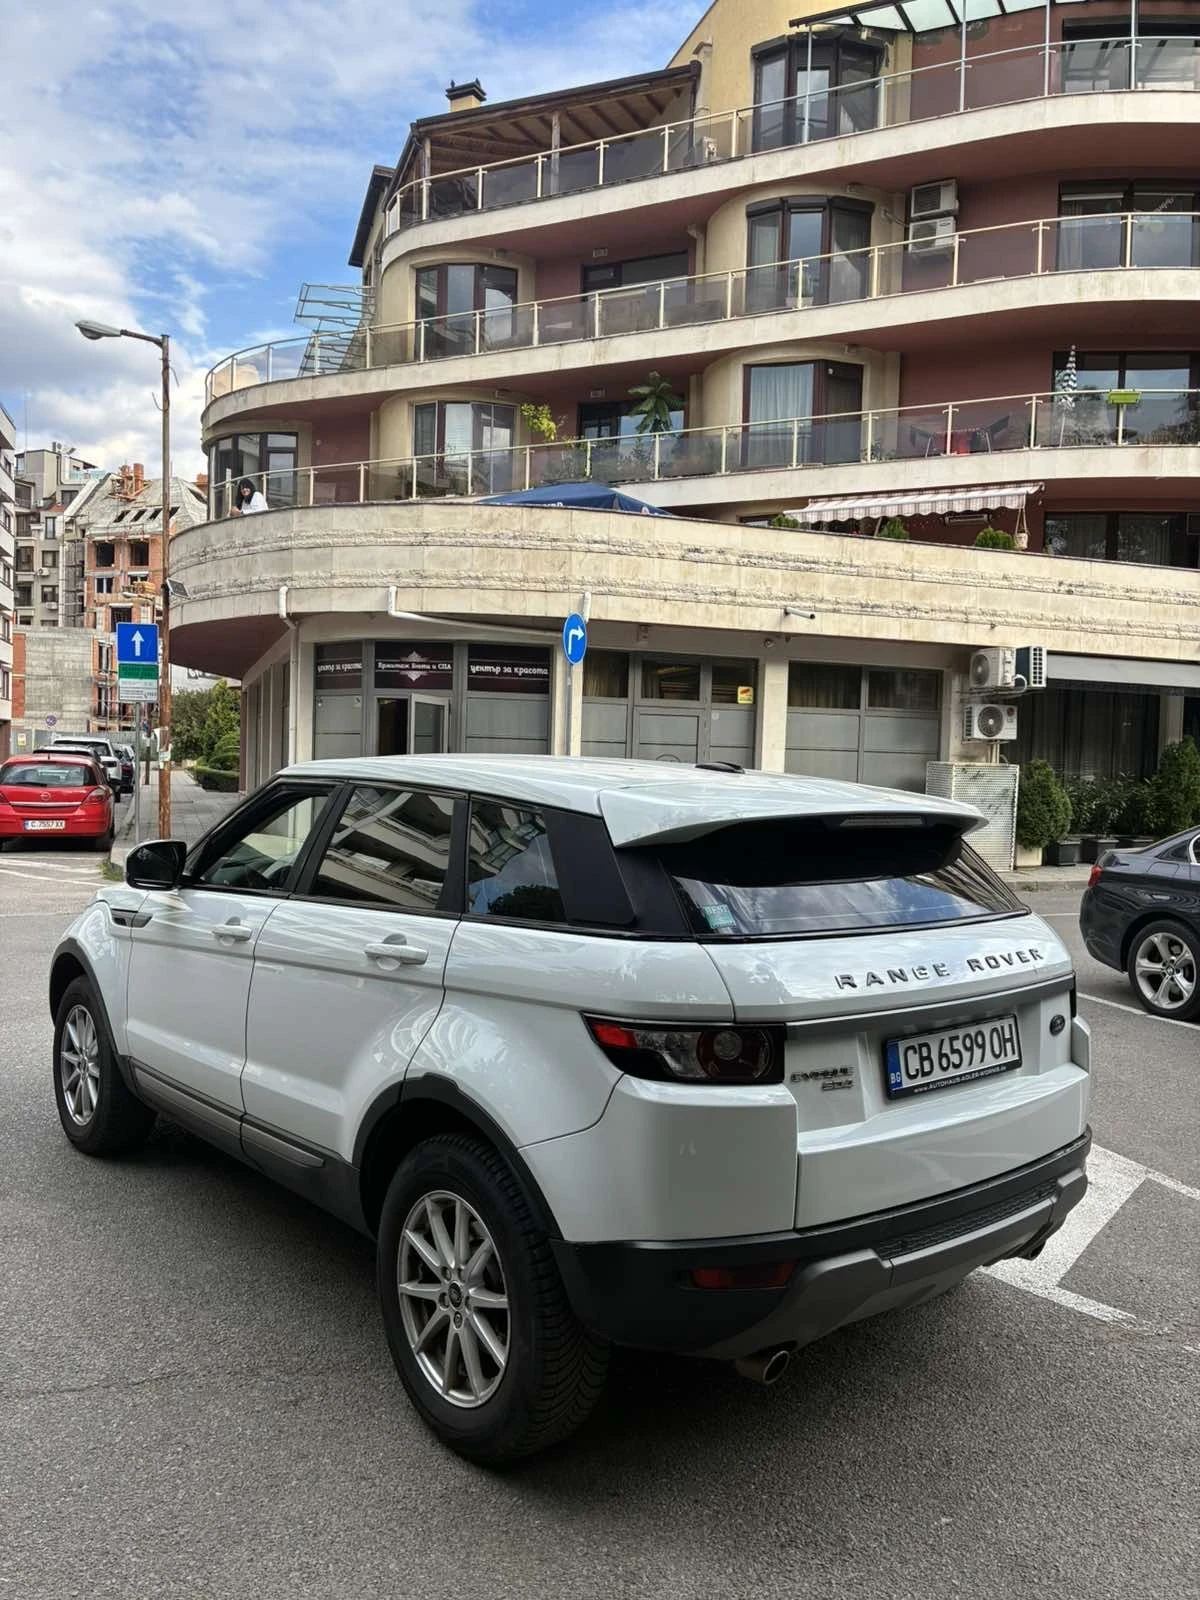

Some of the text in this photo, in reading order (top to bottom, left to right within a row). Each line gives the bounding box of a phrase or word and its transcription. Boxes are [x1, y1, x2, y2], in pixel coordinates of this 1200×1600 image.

[470, 665, 501, 675] център
[514, 666, 549, 676] красота
[834, 948, 1044, 990] RANGE ROVER
[903, 1023, 1016, 1081] CB 6599 OH
[890, 1072, 901, 1084] BG
